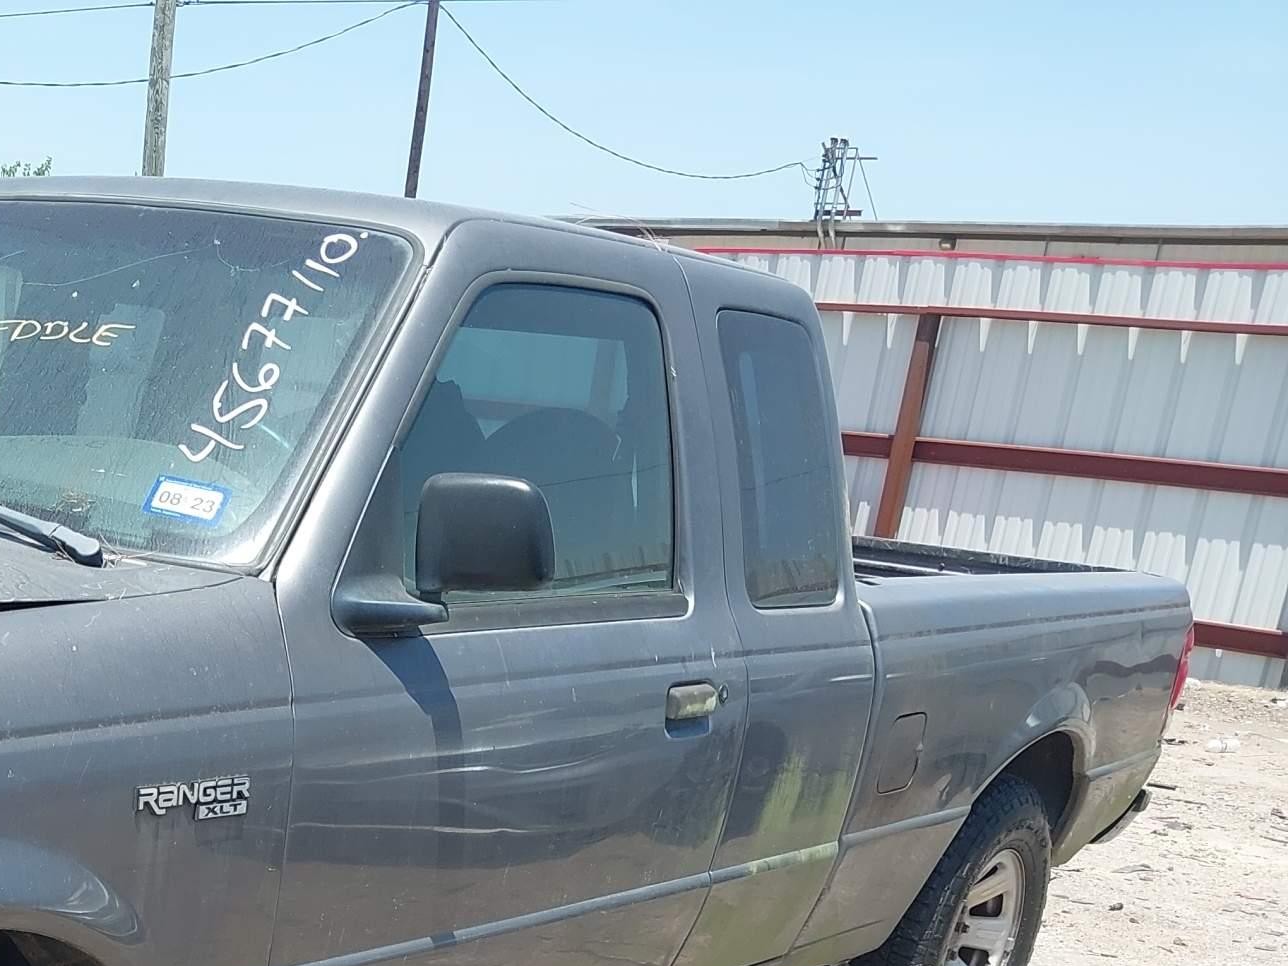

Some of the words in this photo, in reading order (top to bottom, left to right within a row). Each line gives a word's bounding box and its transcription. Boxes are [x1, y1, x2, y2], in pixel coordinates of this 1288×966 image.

[158, 490, 183, 506] 08
[190, 497, 216, 513] 23
[204, 802, 242, 816] XLT
